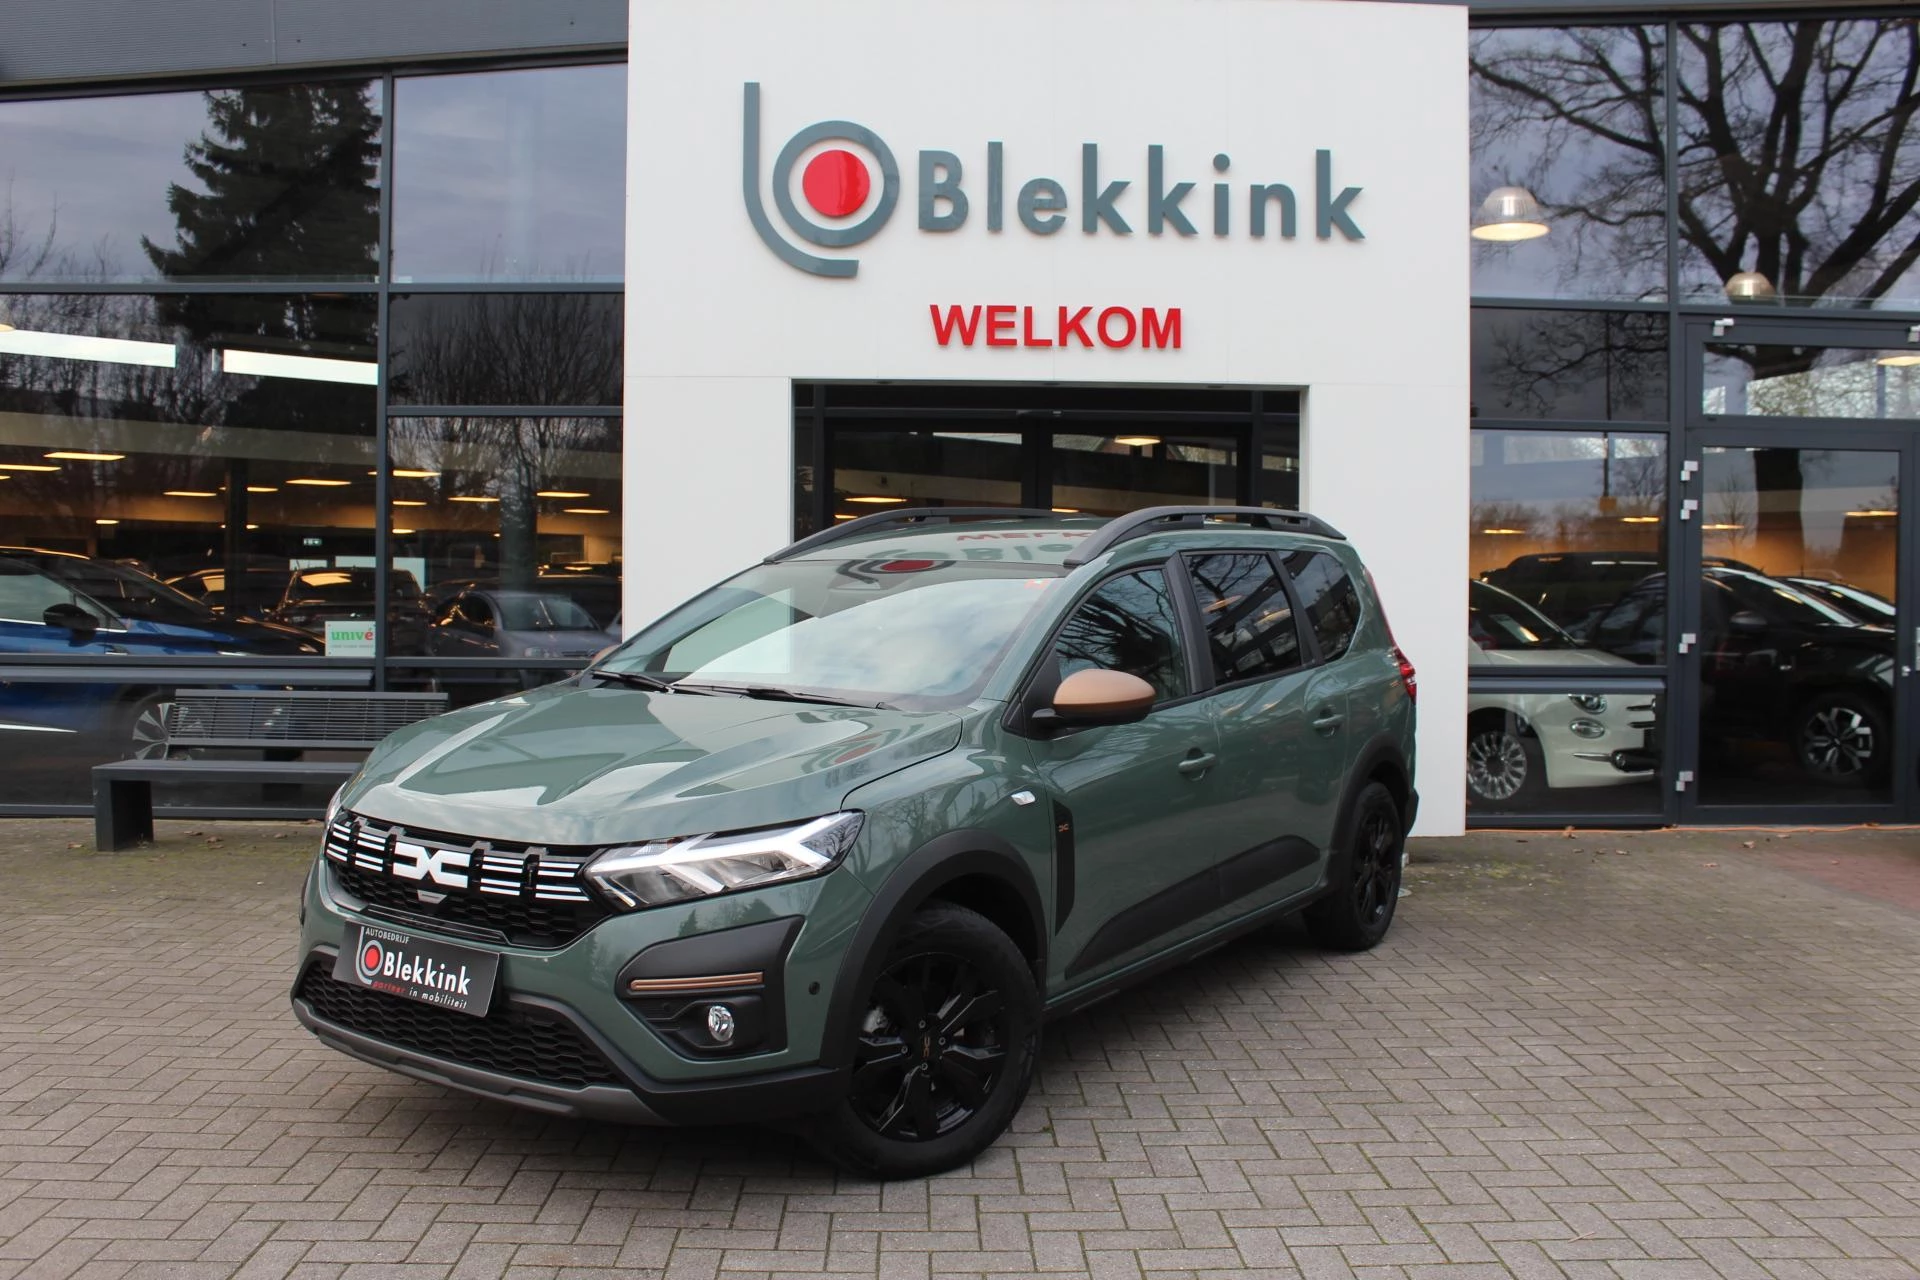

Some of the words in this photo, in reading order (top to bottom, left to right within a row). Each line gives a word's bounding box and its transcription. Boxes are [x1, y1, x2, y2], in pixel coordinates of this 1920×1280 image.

[918, 141, 1366, 240] Blekkink
[929, 304, 1182, 349] WELKOM
[364, 926, 411, 945] AUTOBEDRIJF
[371, 981, 406, 994] partner
[408, 986, 418, 998] in
[421, 992, 467, 1010] mobiliteit
[382, 951, 472, 996] Blekkink
